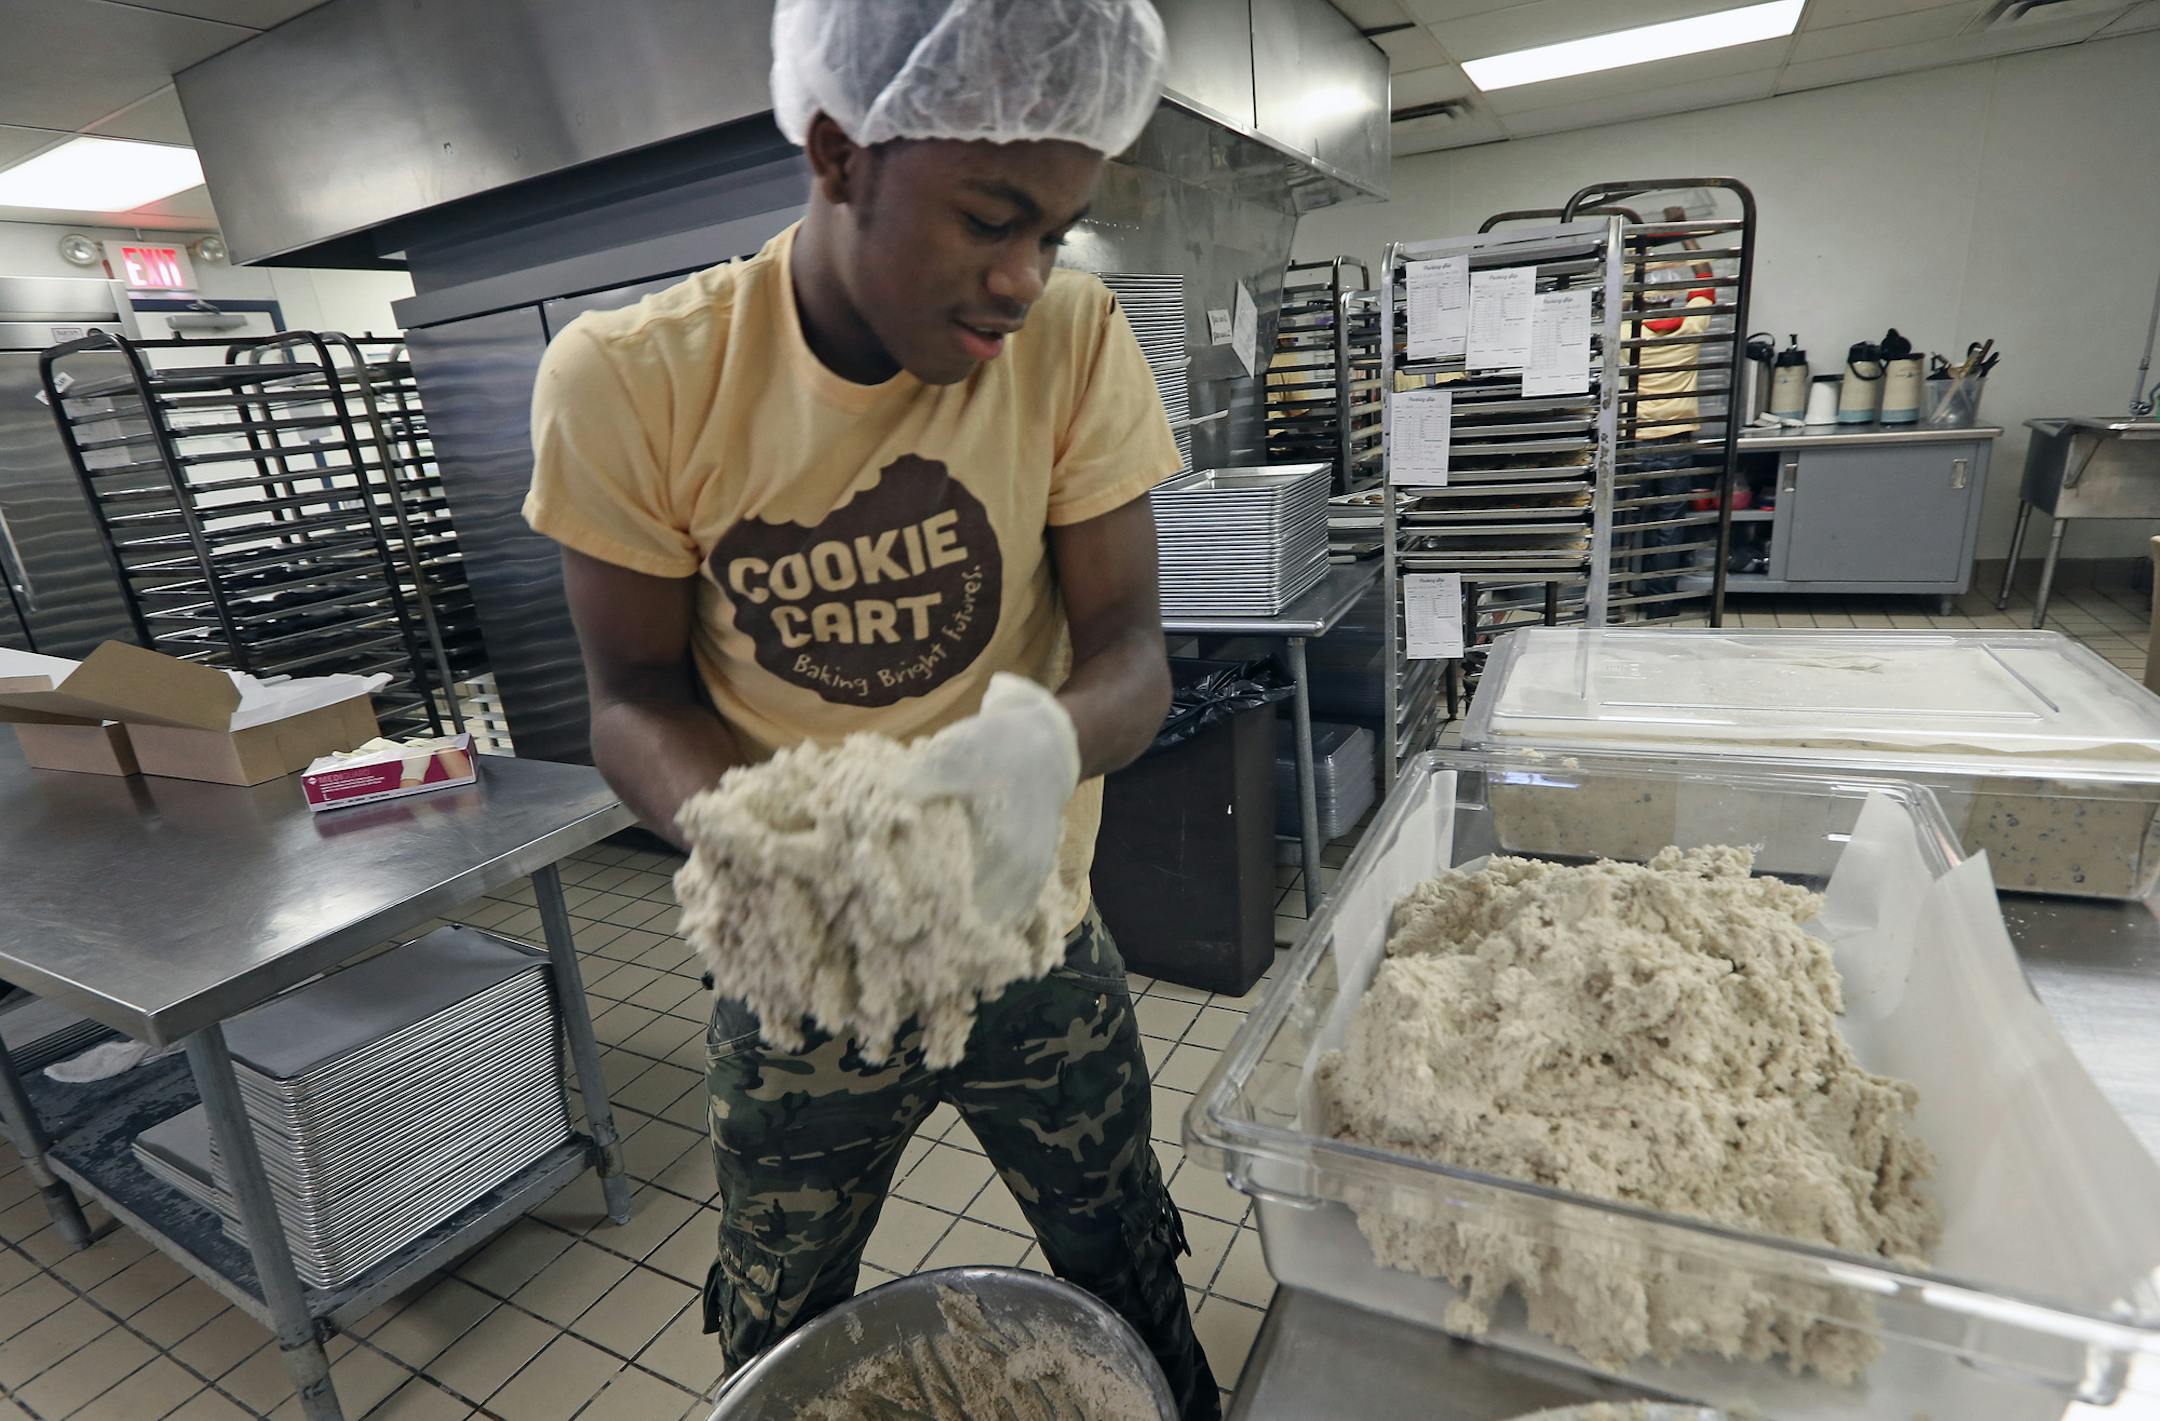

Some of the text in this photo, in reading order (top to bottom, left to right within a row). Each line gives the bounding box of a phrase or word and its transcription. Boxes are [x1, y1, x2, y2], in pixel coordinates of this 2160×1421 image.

[121, 247, 184, 287] EXIT
[728, 509, 968, 603] COOKIE
[771, 592, 942, 648] CART
[793, 653, 868, 696] Baking
[876, 642, 947, 689] Bright
